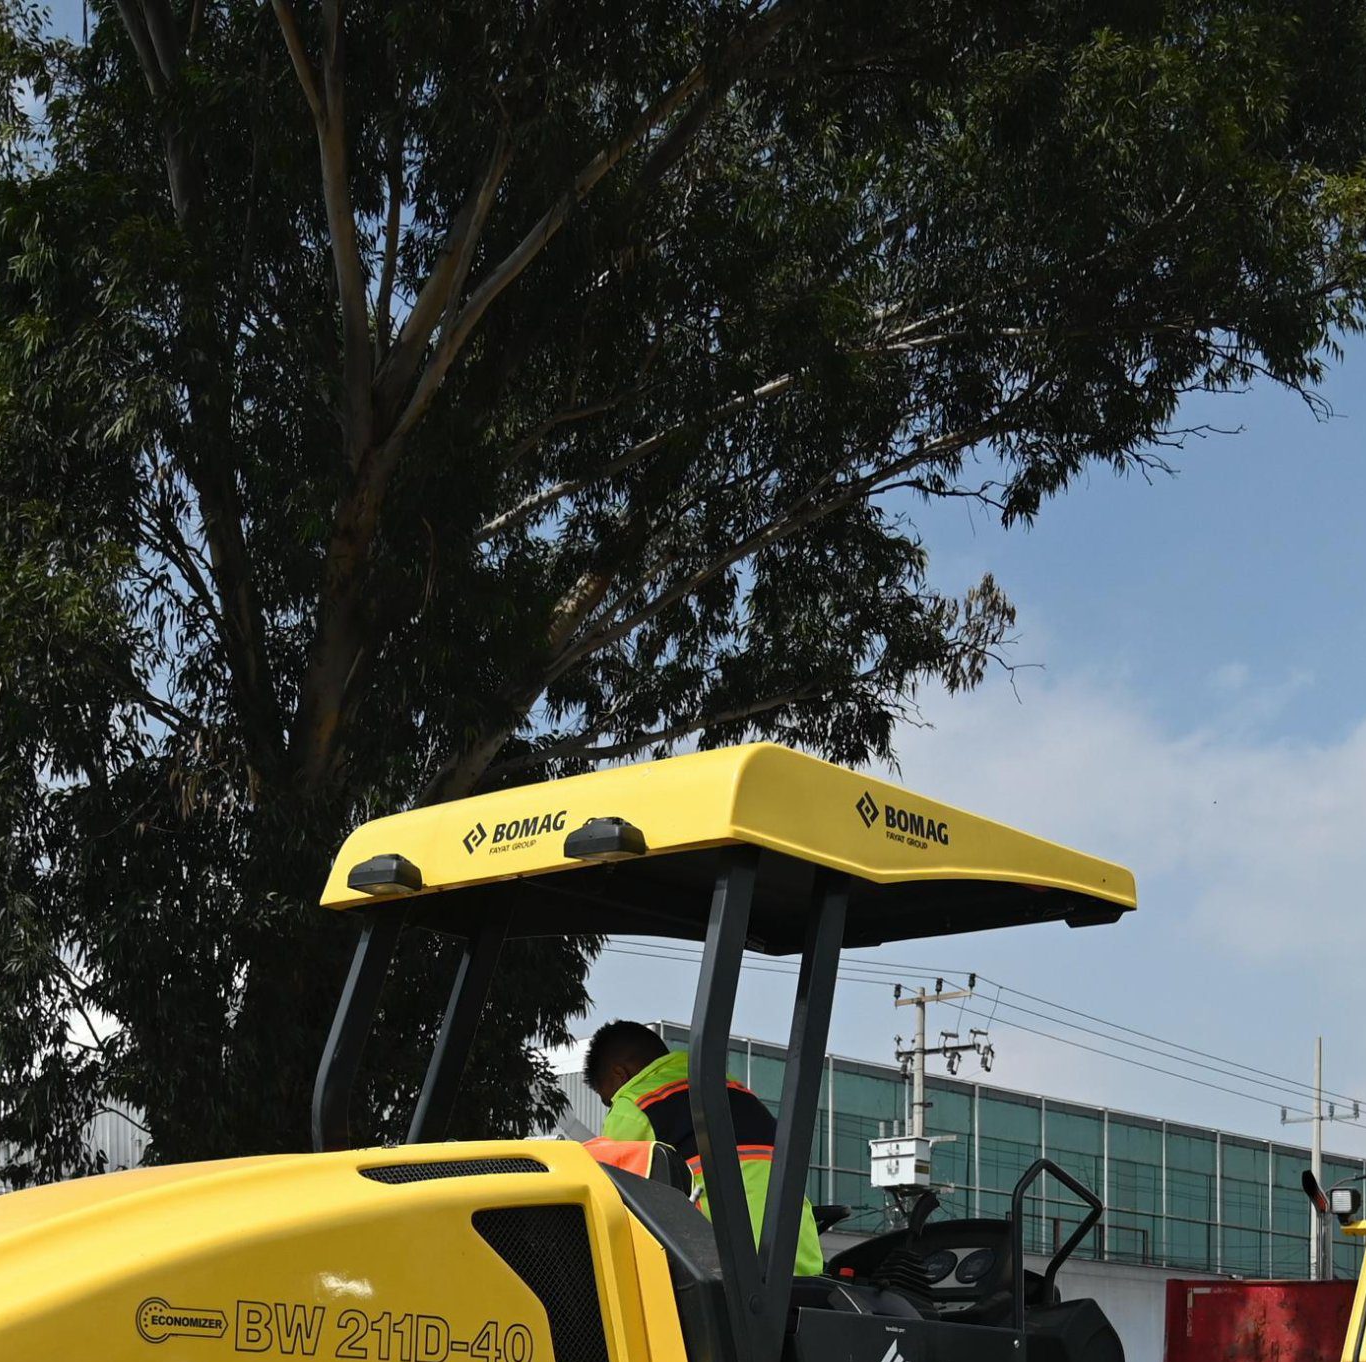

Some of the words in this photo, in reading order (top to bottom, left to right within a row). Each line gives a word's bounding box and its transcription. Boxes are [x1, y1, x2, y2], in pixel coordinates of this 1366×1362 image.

[492, 810, 567, 844] BOMAG
[885, 804, 949, 846] BOMAG
[489, 844, 510, 856] FAYAT
[512, 839, 537, 852] GROUP
[886, 831, 905, 844] FAYAT
[907, 837, 928, 850] GROUP
[151, 1314, 224, 1330] ECONOMIZER
[235, 1299, 325, 1356] BW
